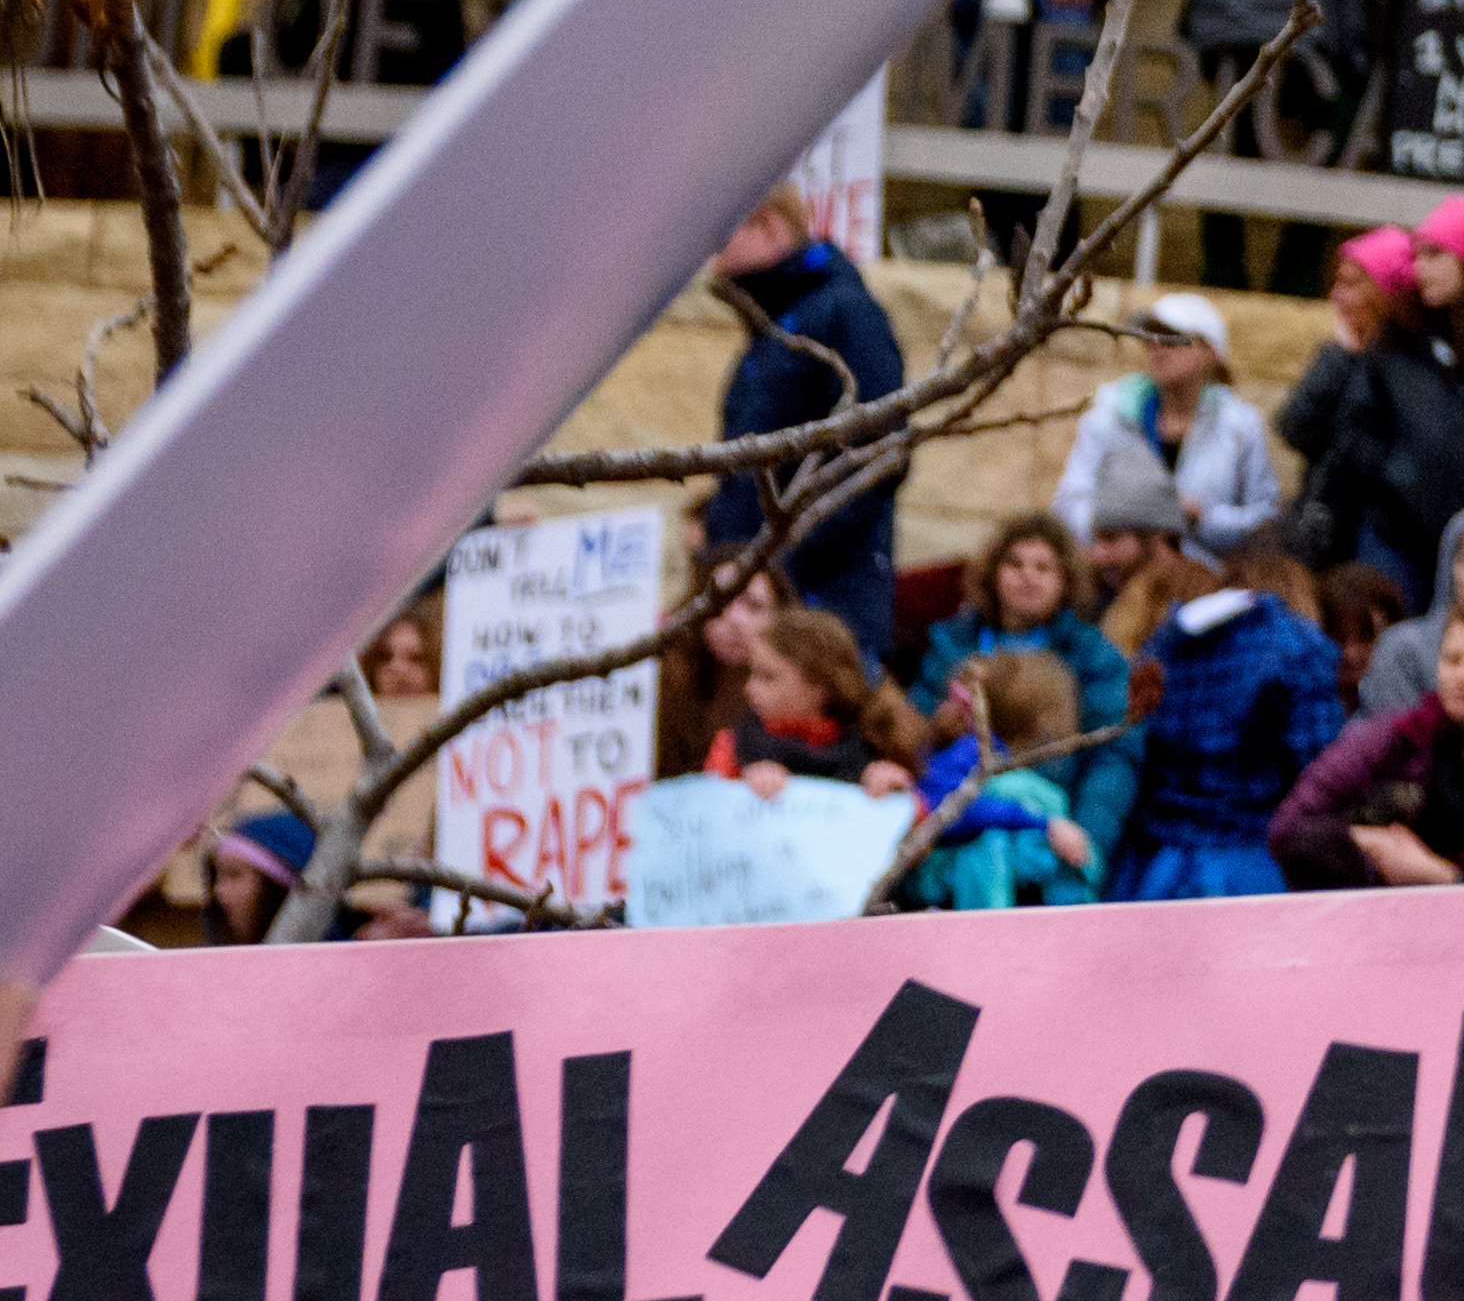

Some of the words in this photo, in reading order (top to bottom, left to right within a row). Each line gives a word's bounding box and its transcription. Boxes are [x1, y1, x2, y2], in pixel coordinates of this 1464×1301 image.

[572, 518, 650, 591] ME
[449, 718, 560, 808] NOT
[565, 728, 628, 773] TO
[482, 774, 650, 904] RAPE
